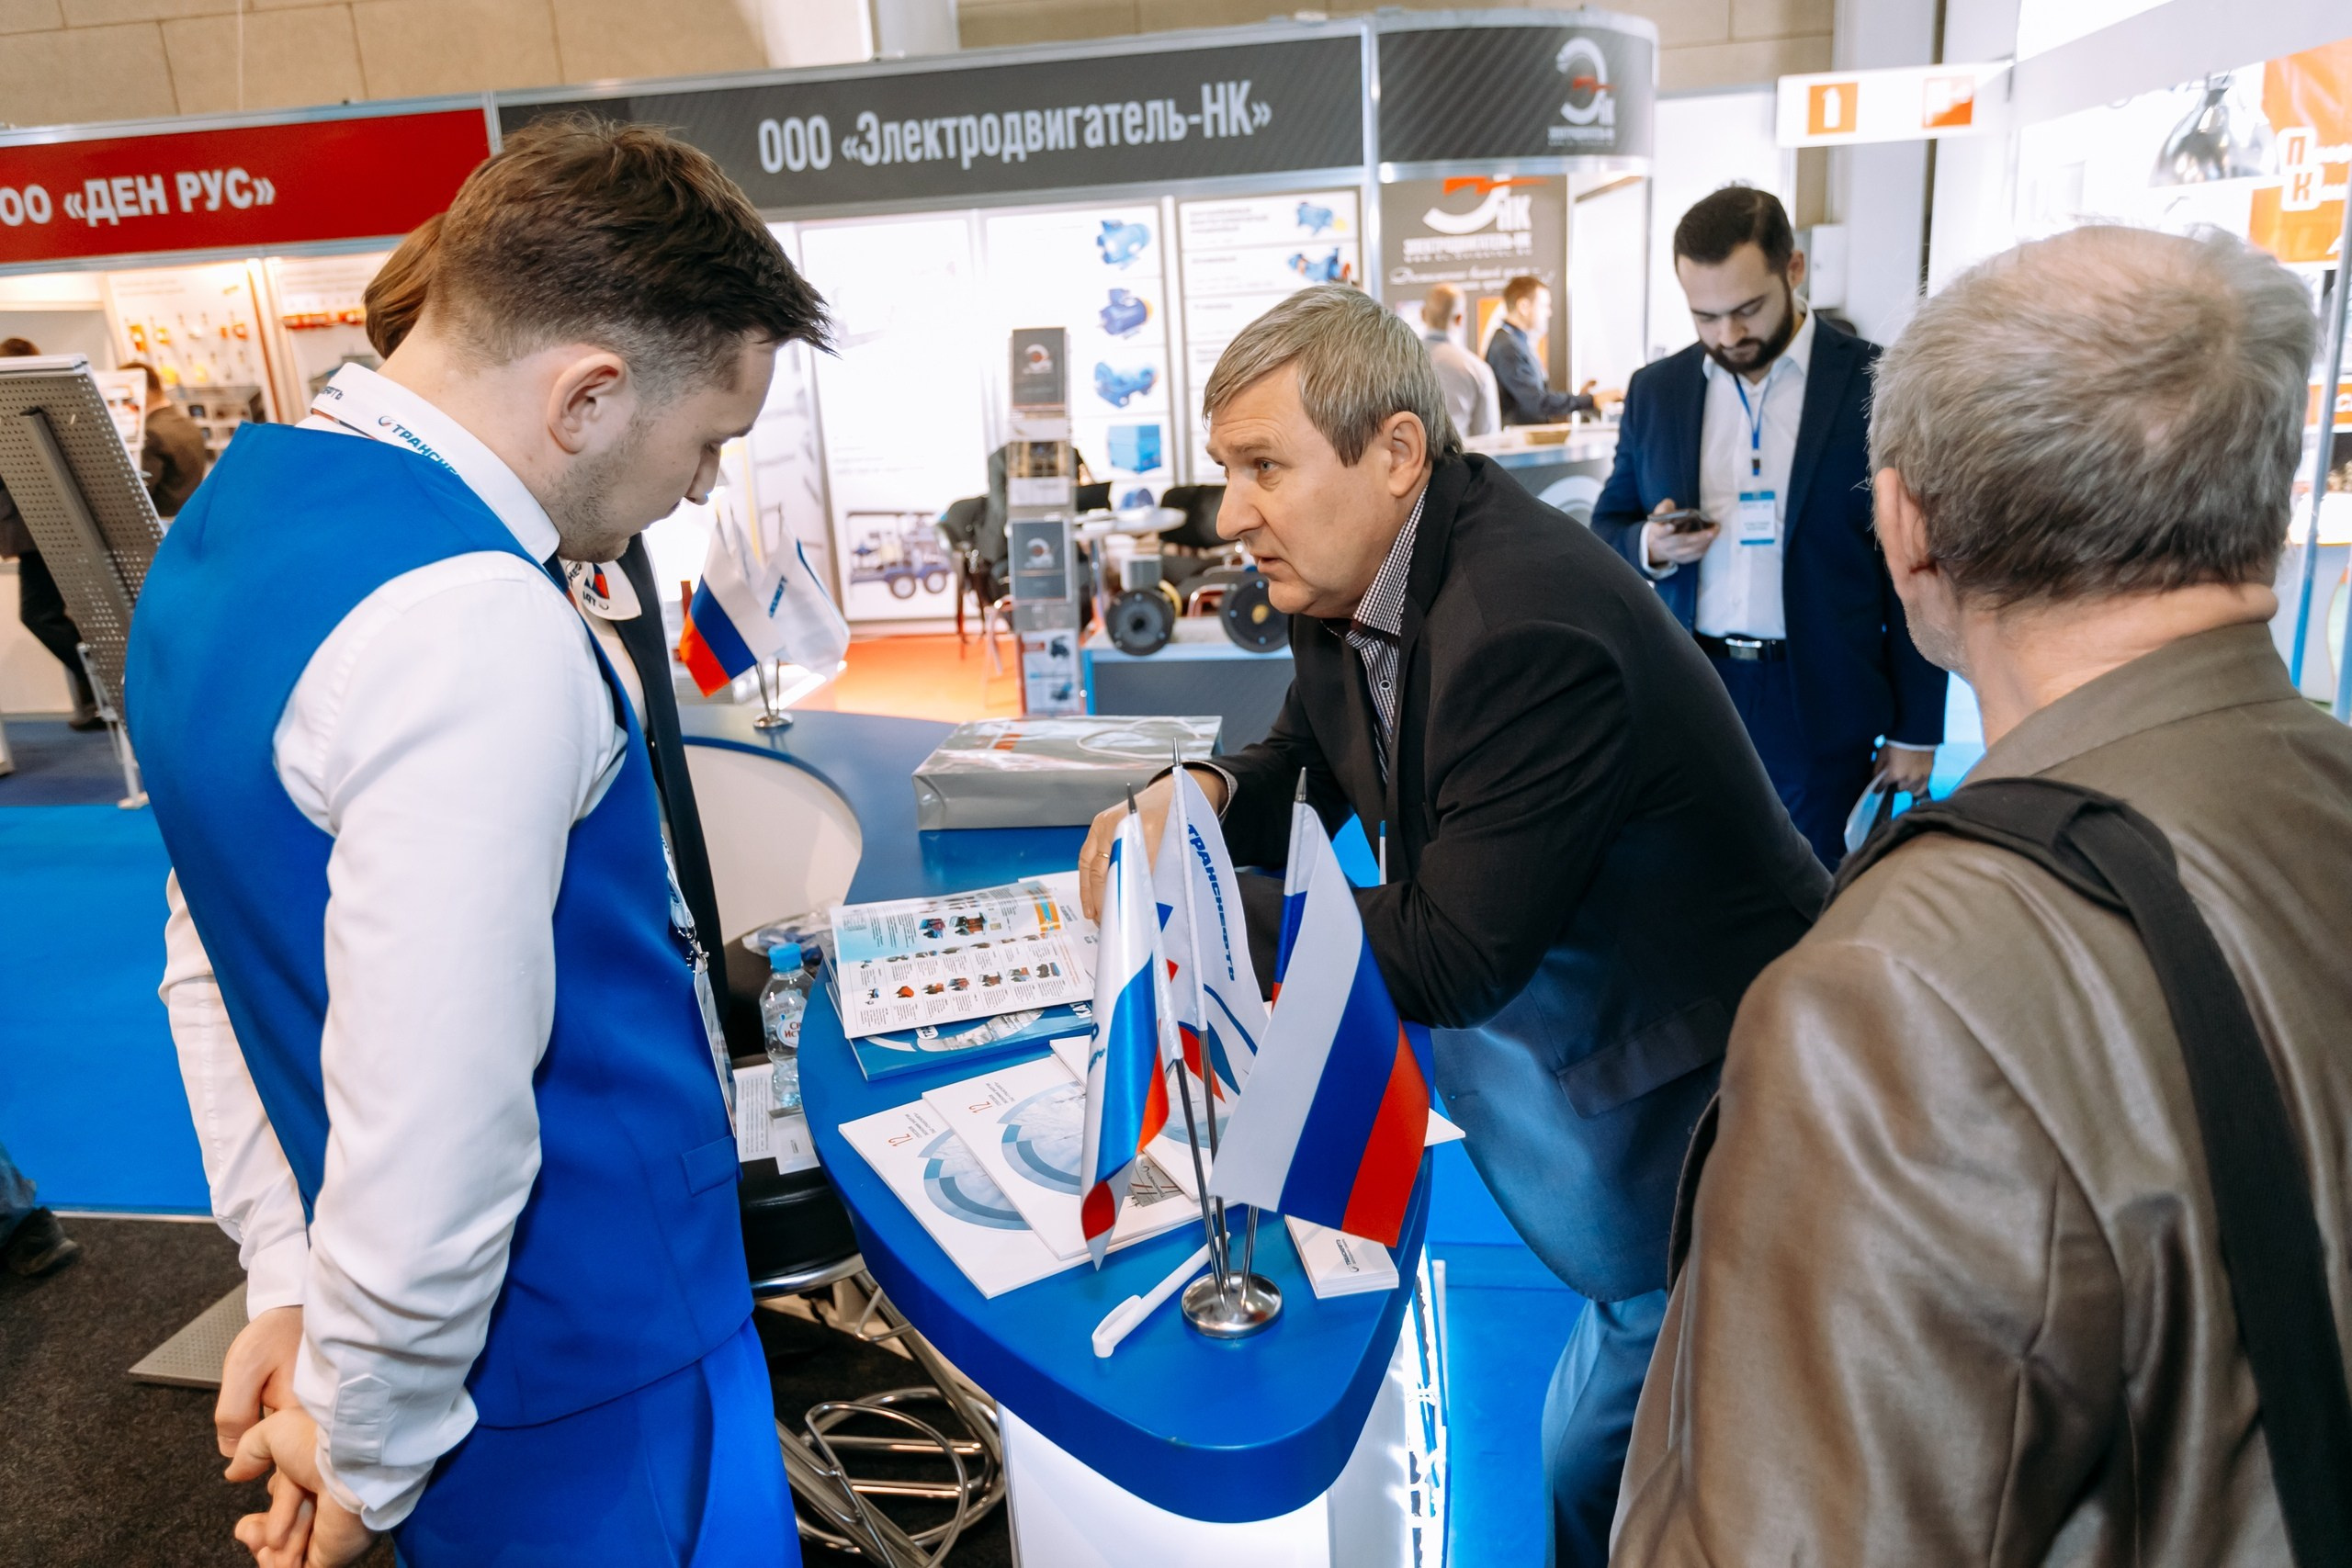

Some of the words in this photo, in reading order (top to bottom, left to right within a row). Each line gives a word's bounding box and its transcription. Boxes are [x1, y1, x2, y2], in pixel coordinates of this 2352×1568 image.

[758, 116, 831, 174] ООО
[841, 81, 1272, 169] «Электродвигатель-НК»
[63, 175, 169, 227] «ДЕН
[175, 167, 276, 213] РУС»
[1188, 823, 1236, 982] ТРАНСНЕФТЬ
